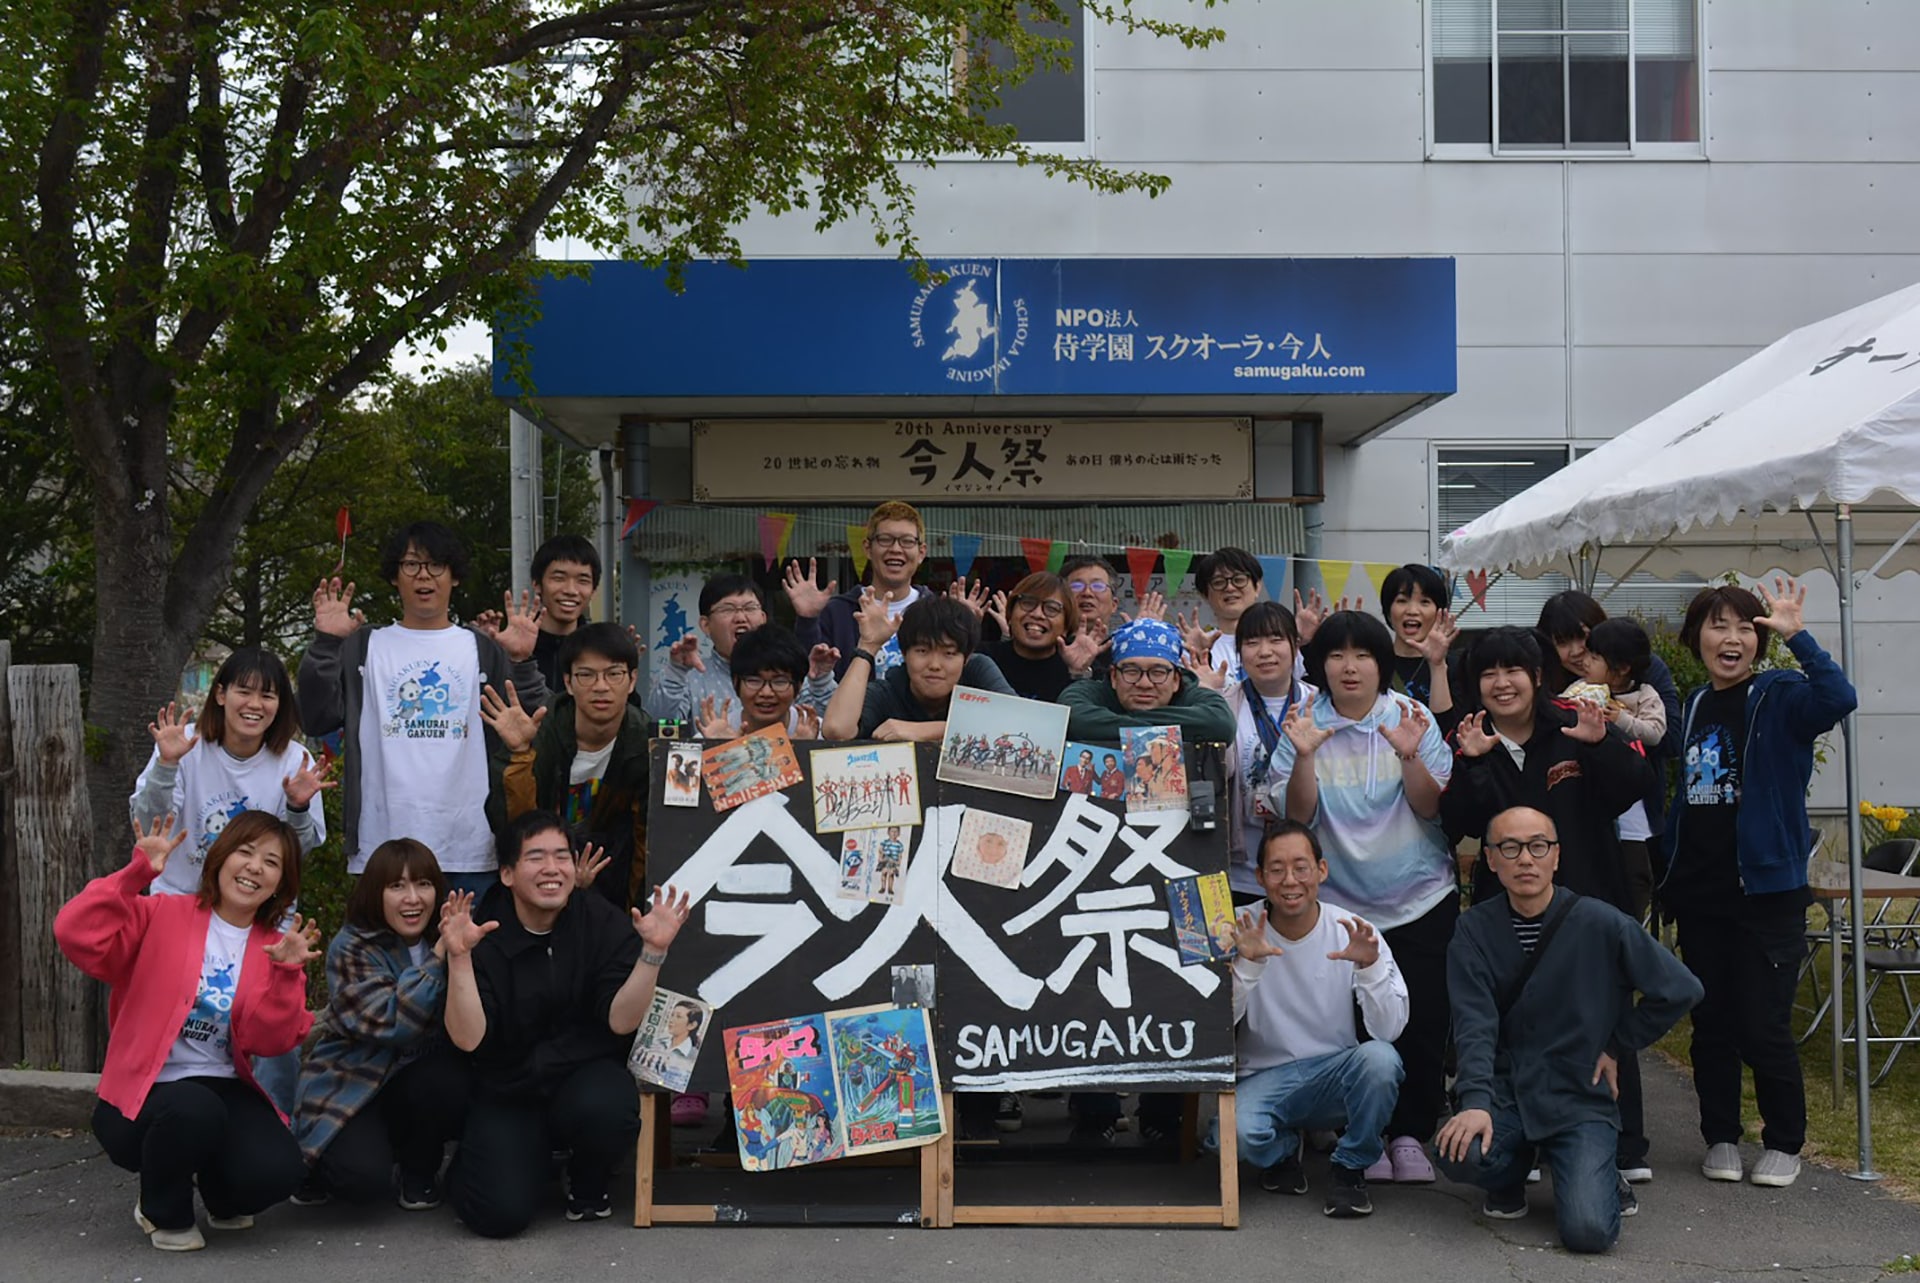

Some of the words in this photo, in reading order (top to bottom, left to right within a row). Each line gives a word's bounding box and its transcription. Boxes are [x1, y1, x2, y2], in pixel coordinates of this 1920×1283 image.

[1007, 298, 1029, 356] SCHOLA
[1055, 308, 1139, 328] NPO法人
[1053, 332, 1134, 362] 侍学園
[1144, 332, 1332, 361] スクオーラ・今人
[946, 356, 1012, 383] IMAGINE
[1233, 363, 1366, 381] samugaku.com
[895, 421, 934, 436] 20th
[942, 421, 1053, 438] Anniversary
[899, 437, 1048, 488] 今人祭
[422, 685, 448, 703] 20
[404, 720, 449, 729] SAMURAI
[407, 729, 445, 738] GAKUEN
[1701, 747, 1719, 766] 20
[646, 787, 1222, 1011] 今人祭
[204, 986, 233, 1012] 20
[736, 1024, 820, 1070] ダイモス
[955, 1014, 1196, 1069] SAMUGAKU
